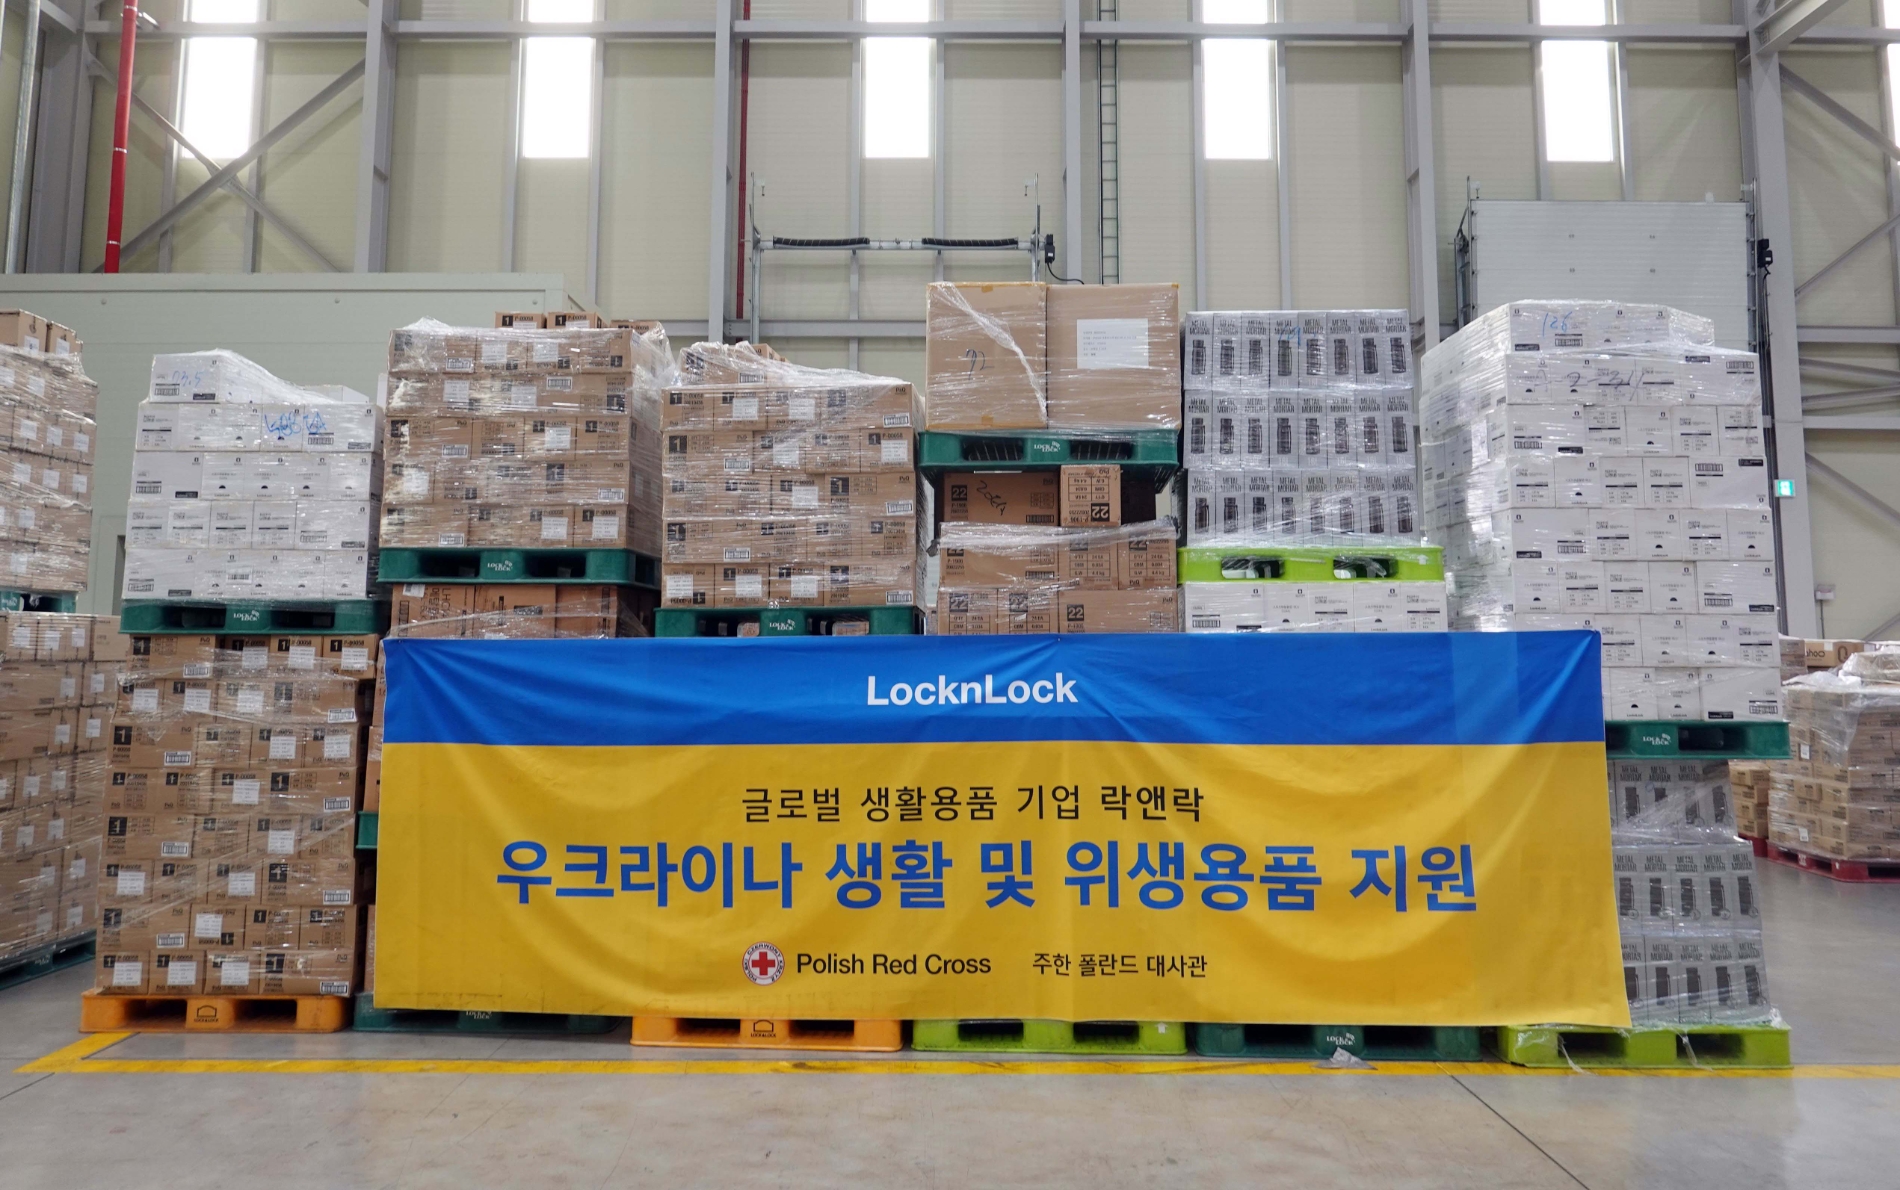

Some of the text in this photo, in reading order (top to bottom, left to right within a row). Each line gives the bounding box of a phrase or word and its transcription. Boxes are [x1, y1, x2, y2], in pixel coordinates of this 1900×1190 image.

[952, 488, 967, 498] 22
[1092, 506, 1108, 518] 22
[1068, 608, 1084, 618] 22
[868, 672, 1078, 706] LocknLock
[742, 785, 1204, 823] 글로벌 생활용품 기업 락앤락
[497, 839, 1477, 913] 우크라이나 생활 및 위생용품 지원
[796, 954, 992, 976] Polish Red Cross
[1032, 953, 1208, 978] 주한 폴란드 대사관
